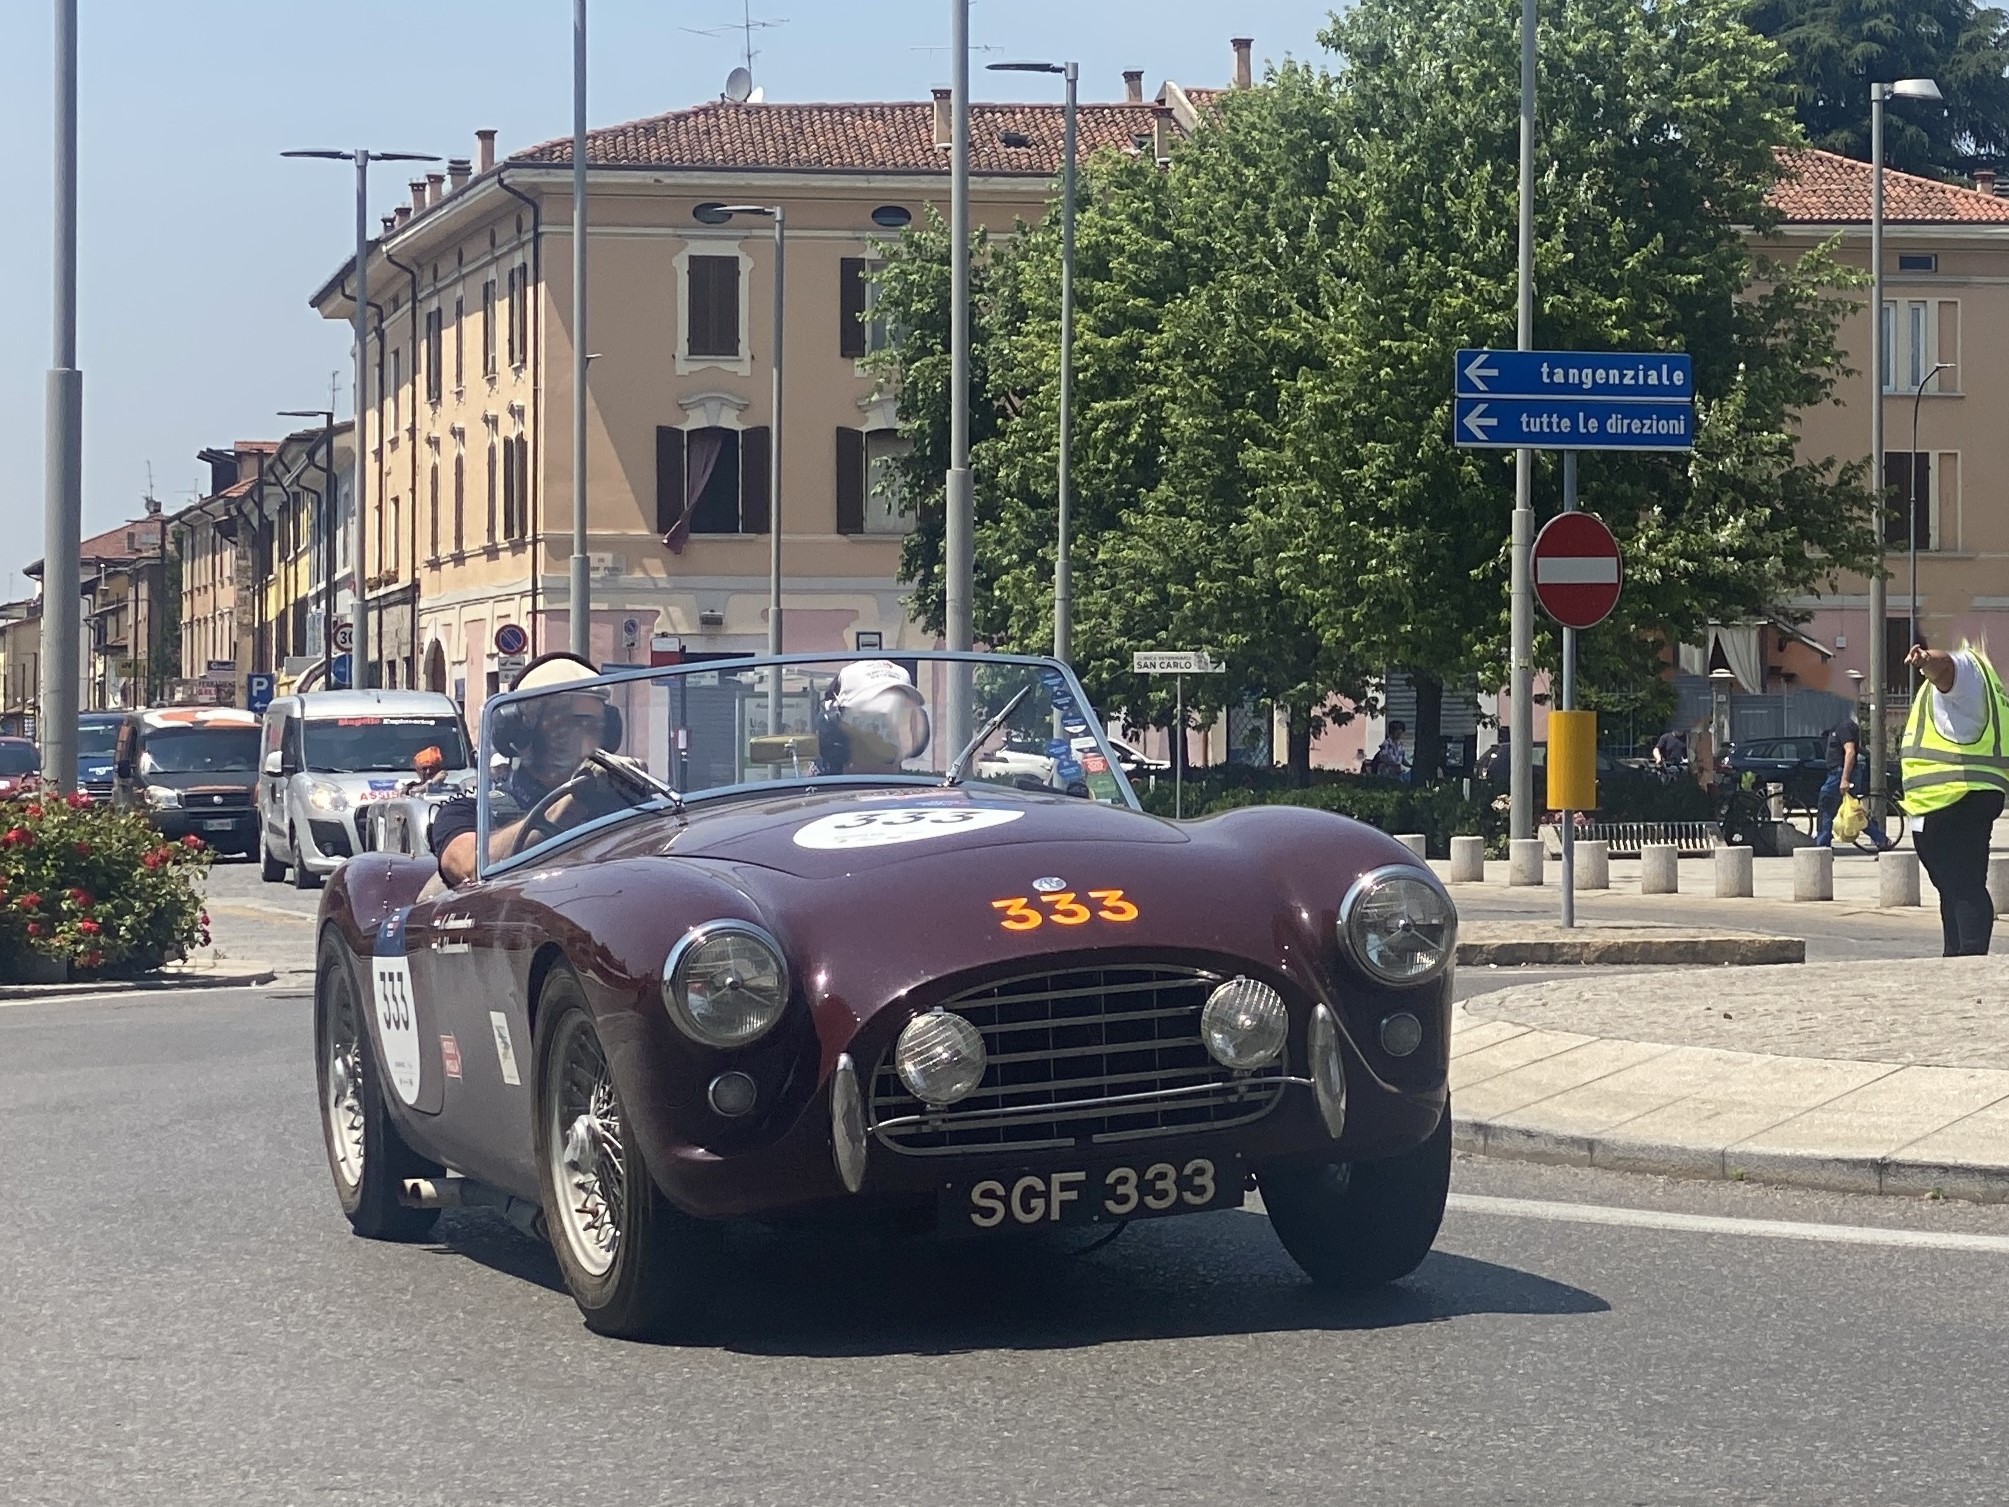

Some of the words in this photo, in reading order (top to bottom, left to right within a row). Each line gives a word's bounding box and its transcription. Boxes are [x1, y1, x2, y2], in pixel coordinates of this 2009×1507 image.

[1541, 362, 1684, 389] tangenziale
[1520, 412, 1571, 432] tutte
[1579, 412, 1599, 433] le
[1606, 414, 1685, 435] direzioni
[1136, 661, 1157, 670] SAN
[1159, 661, 1192, 670] CARLO
[252, 677, 268, 697] P
[834, 811, 984, 829] 333
[991, 889, 1139, 930] 333
[379, 971, 409, 1031] 333
[970, 1171, 1087, 1227] SGF
[1104, 1158, 1216, 1215] 333
